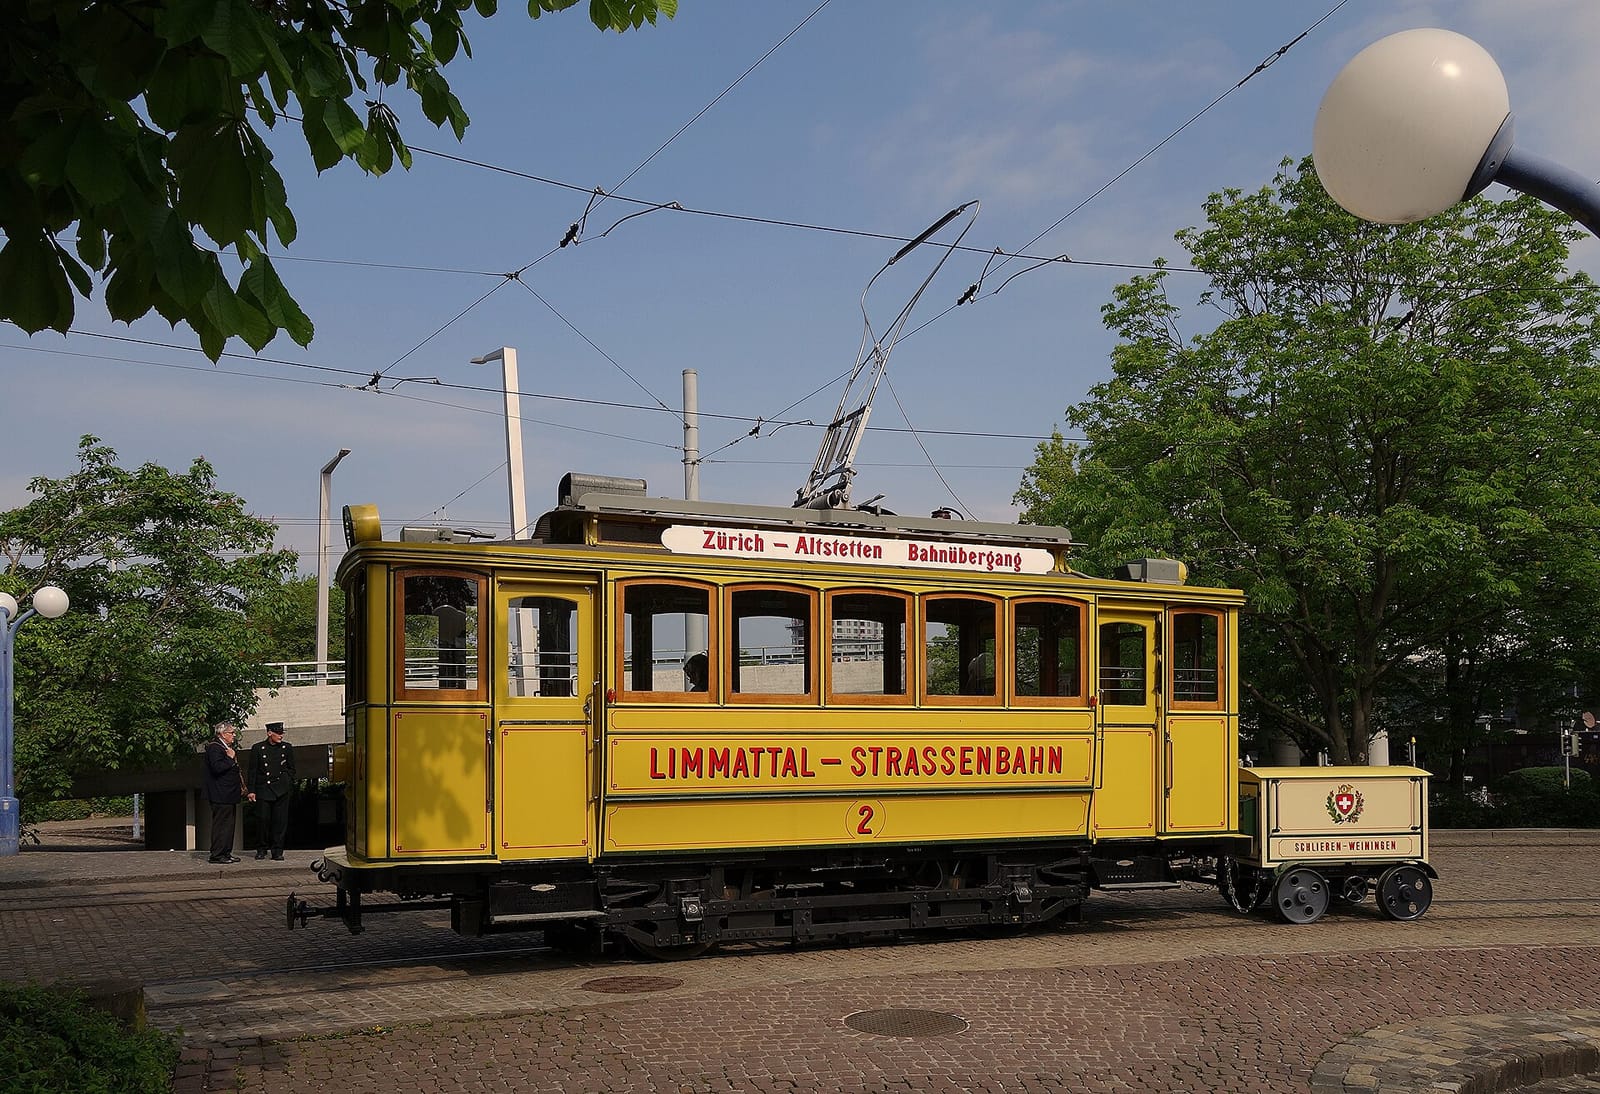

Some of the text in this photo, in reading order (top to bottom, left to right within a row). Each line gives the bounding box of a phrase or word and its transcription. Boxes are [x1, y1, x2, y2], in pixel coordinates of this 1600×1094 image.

[703, 530, 765, 552] Zürich
[795, 535, 883, 559] Altstetten
[908, 543, 1022, 573] Bahnübergang
[649, 746, 817, 780] LIMMATTAL
[850, 745, 1063, 777] STRASSENBAHN
[857, 804, 875, 835] 2
